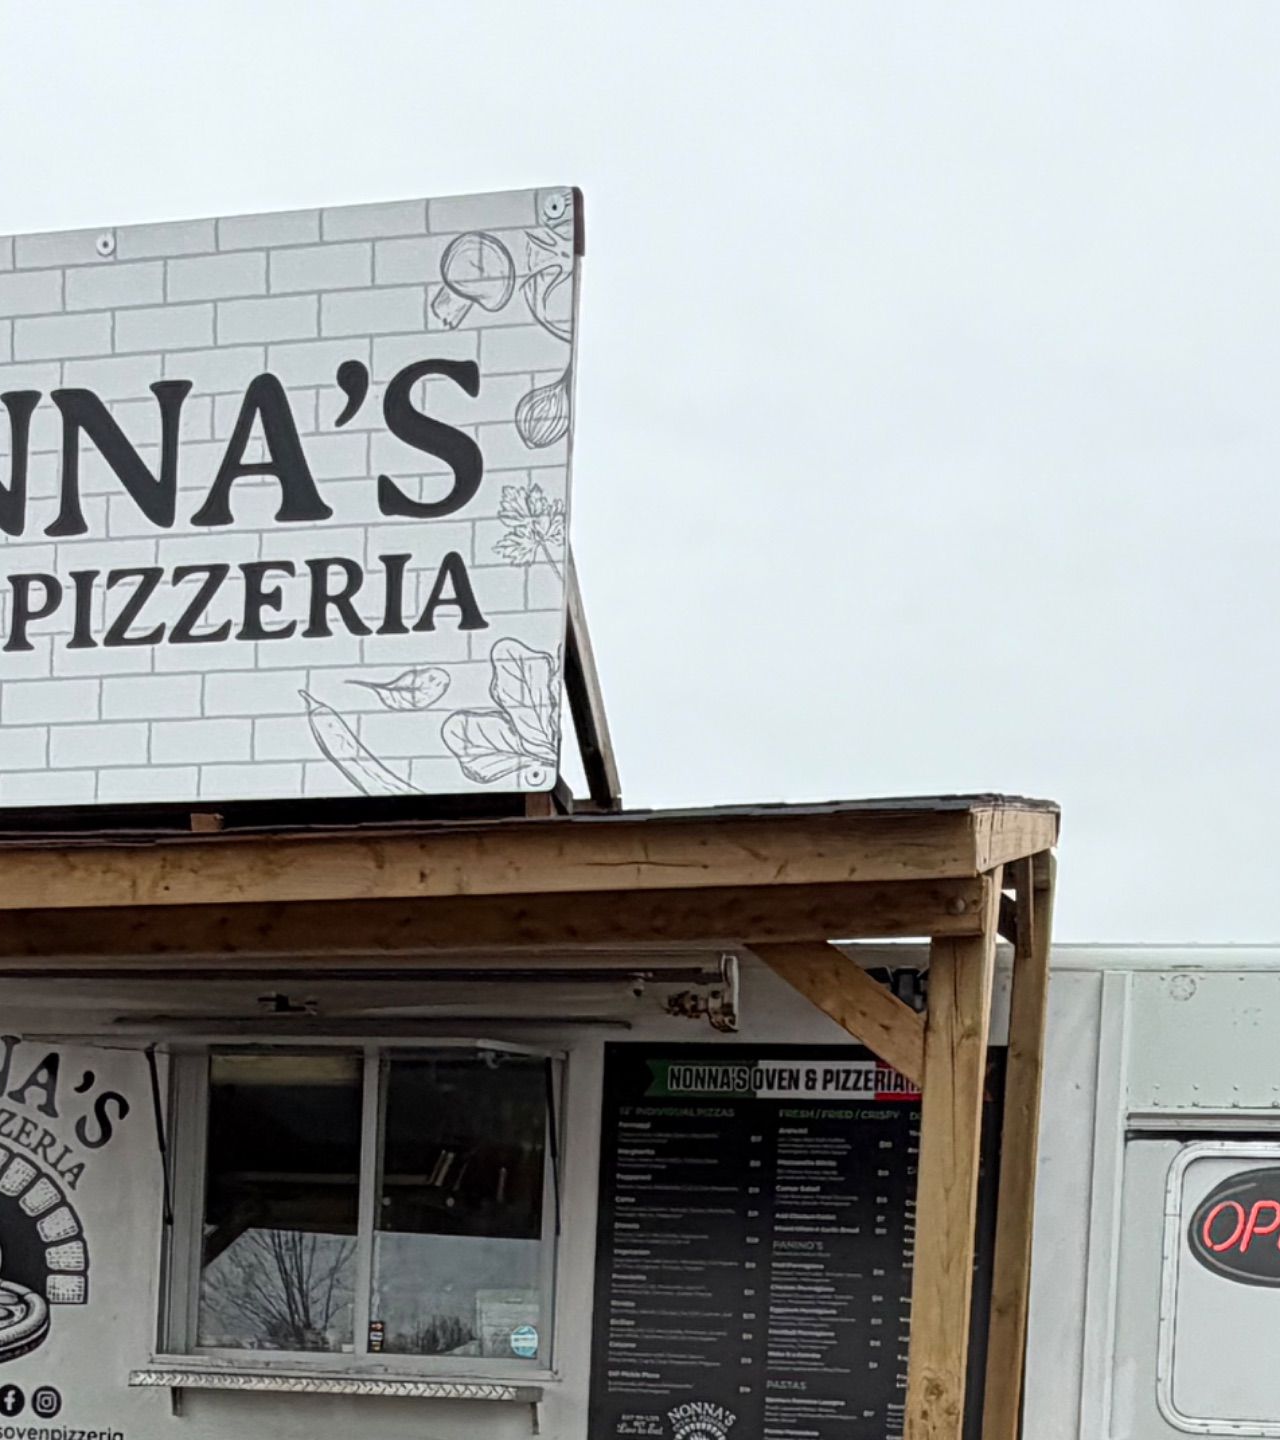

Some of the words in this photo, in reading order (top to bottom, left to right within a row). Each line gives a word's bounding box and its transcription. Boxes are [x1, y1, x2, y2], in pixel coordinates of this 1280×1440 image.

[3, 551, 489, 652] PIZZERIA
[669, 1065, 750, 1091] NONNA'S
[752, 1066, 801, 1091] OVEN
[805, 1067, 817, 1090] &
[822, 1068, 904, 1092] PIZZERIA
[667, 1401, 736, 1426] NONNA'S
